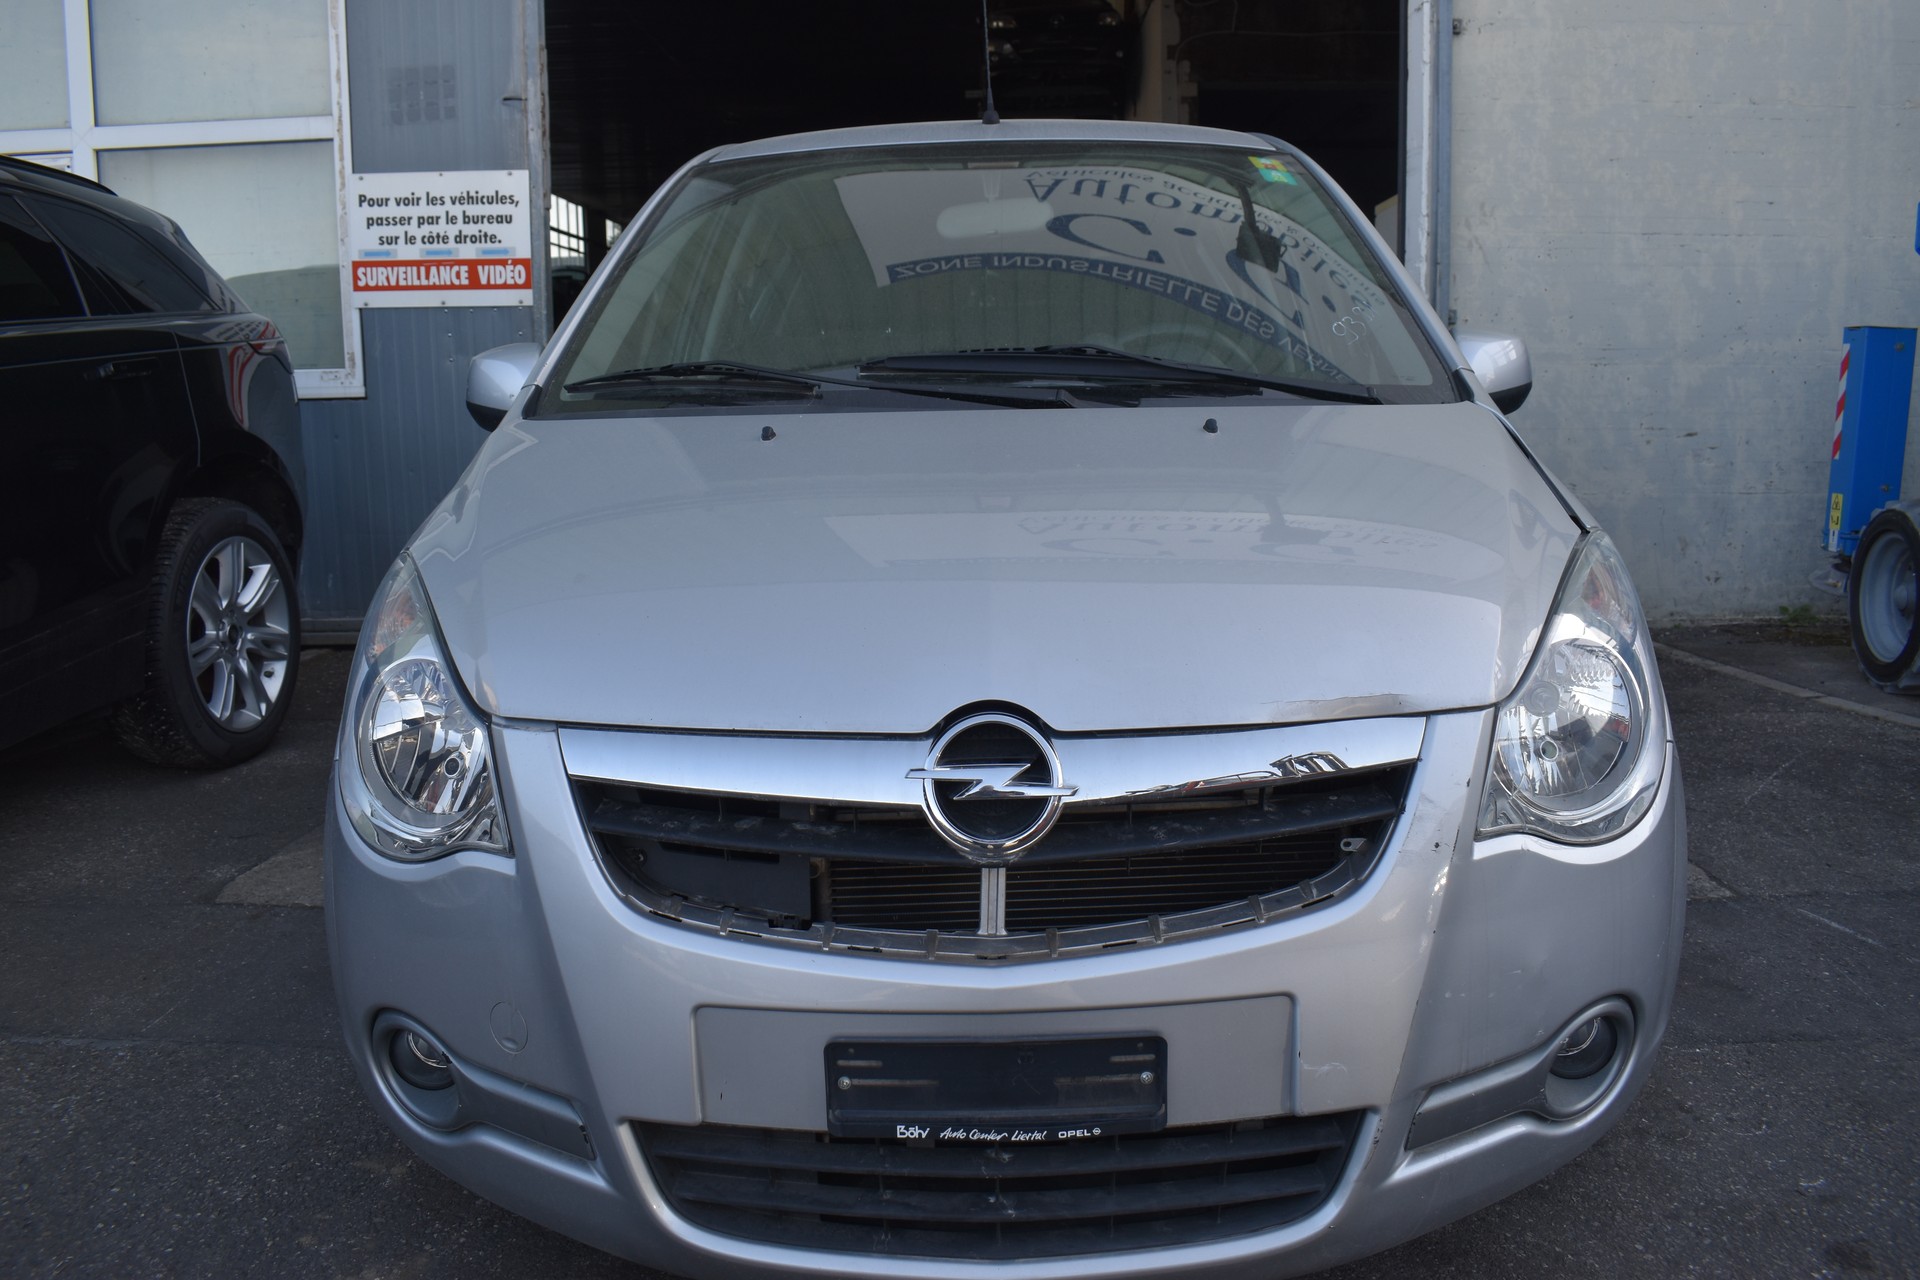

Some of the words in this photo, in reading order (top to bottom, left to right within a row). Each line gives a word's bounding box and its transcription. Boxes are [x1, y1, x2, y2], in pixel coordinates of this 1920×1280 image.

[358, 193, 391, 208] Pour
[394, 191, 422, 207] voir
[426, 191, 446, 206] les
[450, 189, 520, 208] véhicules,
[366, 215, 413, 230] passer
[416, 214, 441, 229] par
[445, 210, 458, 225] le
[462, 209, 513, 225] bureau
[378, 233, 400, 246] sur
[404, 230, 417, 245] le
[421, 230, 450, 245] côté
[454, 229, 502, 245] droite.
[356, 264, 469, 287] SURVEILLANCE
[477, 259, 527, 285] VIDÉO
[939, 1127, 967, 1140] Auto
[969, 1128, 1009, 1141] Center
[1058, 1128, 1092, 1139] OPEL
